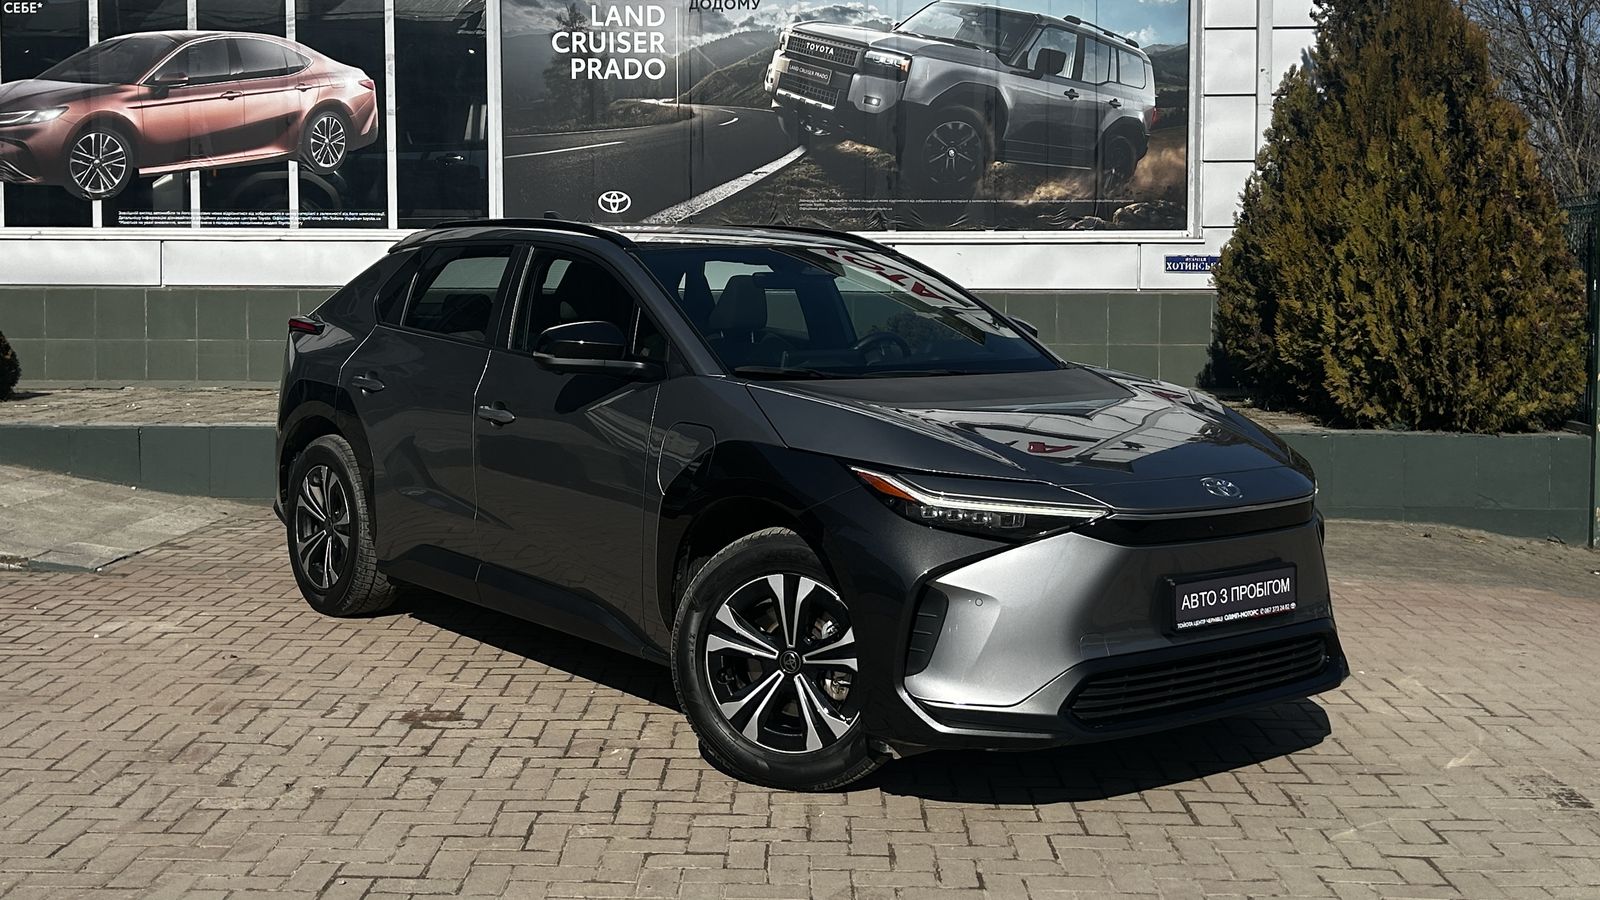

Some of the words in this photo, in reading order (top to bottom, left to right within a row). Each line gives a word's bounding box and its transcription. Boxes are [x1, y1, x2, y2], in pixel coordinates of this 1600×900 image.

[591, 5, 665, 26] LAND
[689, 0, 760, 12] ДОДОМУ
[551, 31, 666, 53] CRUISER
[806, 42, 834, 55] TOYOTA
[571, 58, 666, 80] PRADO
[789, 64, 799, 72] LAND
[799, 67, 815, 75] CRUISER
[814, 71, 829, 80] PRADO
[1181, 590, 1217, 610] АВТО
[1231, 577, 1290, 601] ПРОБІГОМ
